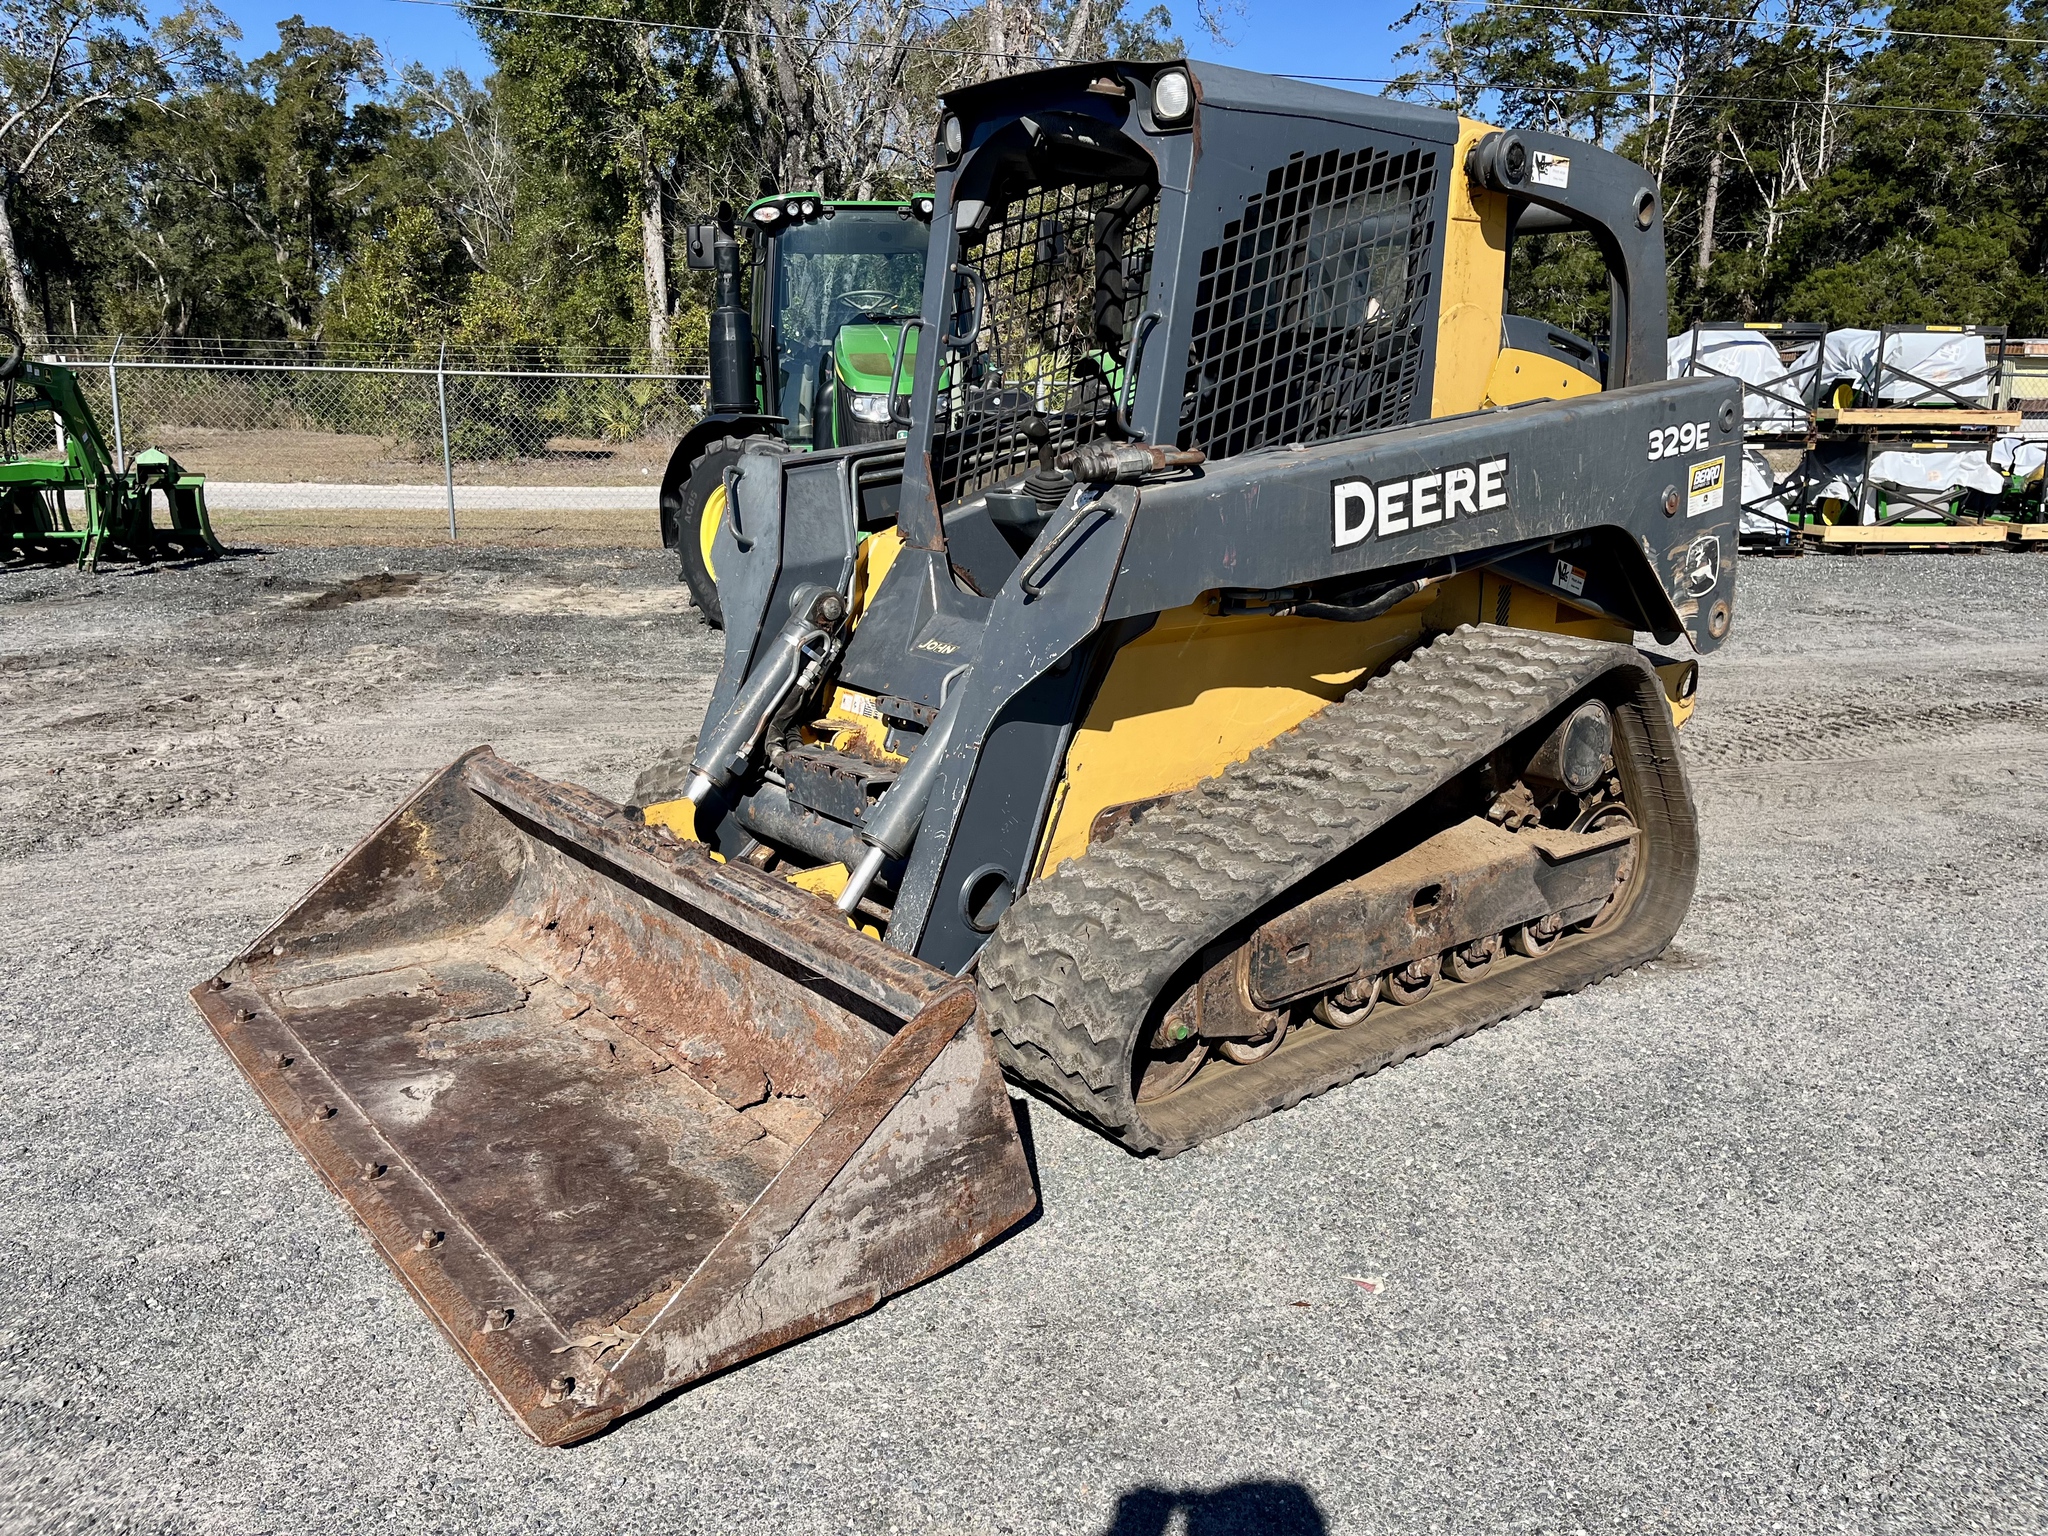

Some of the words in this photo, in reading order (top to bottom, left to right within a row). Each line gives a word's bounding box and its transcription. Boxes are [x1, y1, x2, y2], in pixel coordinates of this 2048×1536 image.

[1648, 422, 1710, 460] 329E
[1694, 465, 1720, 486] BEARD
[1334, 458, 1506, 547] DEERE
[918, 638, 956, 654] JOHN
